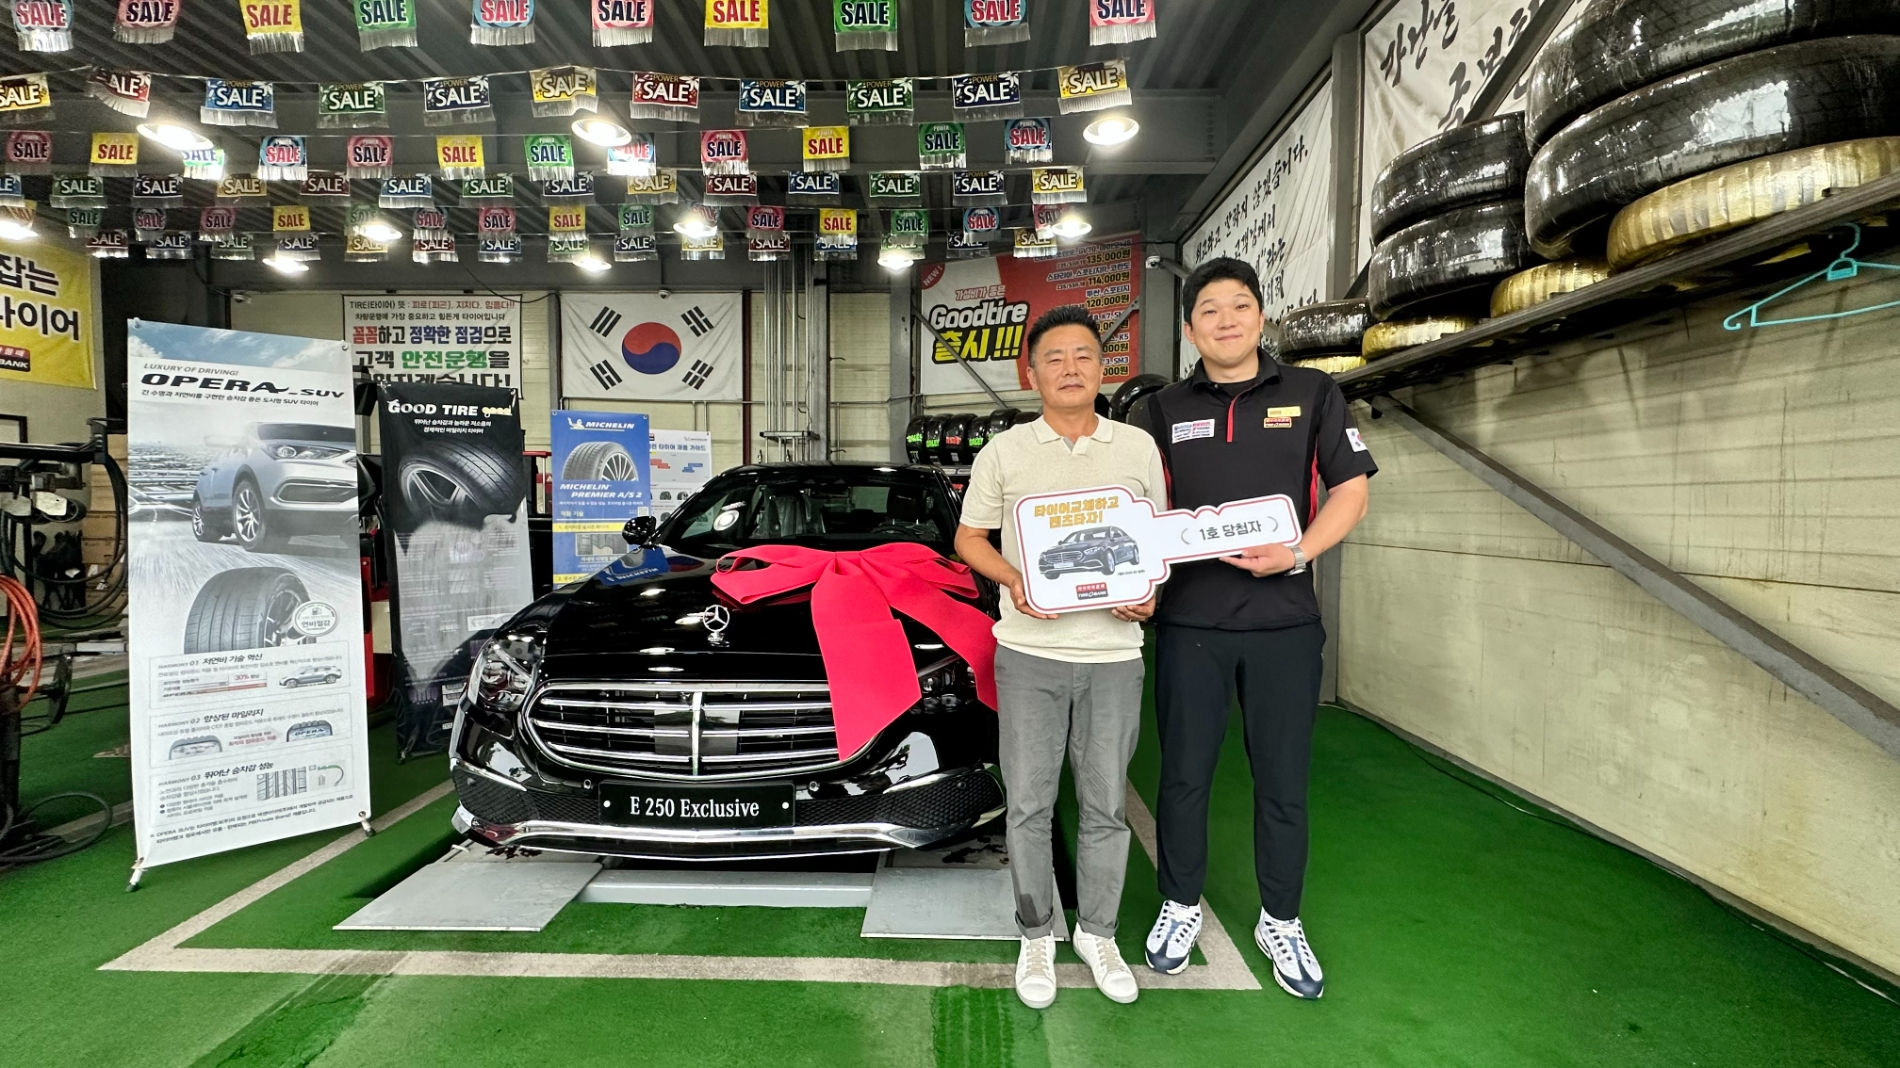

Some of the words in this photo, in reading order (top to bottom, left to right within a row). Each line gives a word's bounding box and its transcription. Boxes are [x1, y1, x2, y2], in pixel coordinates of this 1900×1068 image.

[16, 3, 66, 26] SALE
[126, 1, 174, 22] SALE
[247, 4, 292, 27] SALE
[360, 1, 407, 24] SALE
[482, 1, 528, 21] SALE
[599, 0, 645, 21] SALE
[713, 1, 760, 22] SALE
[842, 2, 889, 25] SALE
[972, 0, 1021, 21] SALE
[1099, 0, 1146, 19] SALE
[542, 72, 588, 98] SALE
[1070, 68, 1119, 94] SALE
[217, 87, 263, 107] SALE
[329, 91, 375, 109] SALE
[435, 86, 480, 107] SALE
[643, 82, 690, 102] SALE
[750, 88, 796, 108] SALE
[858, 88, 904, 108] SALE
[964, 81, 1011, 104] SALE
[925, 133, 960, 151] SALE
[1010, 129, 1046, 146] SALE
[14, 142, 48, 158] SALE
[99, 144, 134, 160] SALE
[354, 146, 387, 162] SALE
[442, 146, 476, 162] SALE
[530, 145, 565, 162] SALE
[707, 142, 741, 158] SALE
[809, 138, 843, 154] SALE
[266, 147, 301, 163] SALE
[61, 180, 97, 194] SALE
[142, 180, 177, 194] SALE
[225, 179, 260, 194] SALE
[307, 178, 342, 192] SALE
[388, 179, 424, 193] SALE
[470, 180, 506, 193] SALE
[552, 180, 587, 193] SALE
[633, 177, 670, 191] SALE
[714, 178, 750, 192] SALE
[796, 177, 833, 190] SALE
[877, 179, 914, 193] SALE
[961, 179, 998, 192] SALE
[1040, 174, 1077, 190] SALE
[70, 211, 99, 225] SALE
[137, 213, 164, 228] SALE
[206, 214, 233, 228] SALE
[278, 213, 305, 227] SALE
[416, 212, 445, 228] SALE
[484, 214, 511, 229] SALE
[554, 214, 581, 228] SALE
[623, 210, 650, 225] SALE
[752, 213, 779, 228] SALE
[824, 217, 852, 231] SALE
[896, 218, 924, 233] SALE
[968, 216, 996, 230] SALE
[92, 231, 121, 246] SALE
[157, 235, 185, 248] SALE
[220, 234, 247, 248] SALE
[285, 237, 313, 249] SALE
[421, 239, 449, 250] SALE
[487, 239, 515, 251] SALE
[555, 240, 583, 251] SALE
[621, 239, 650, 250] SALE
[755, 238, 784, 249] SALE
[391, 313, 406, 321] 가장
[407, 313, 436, 321] 중요하고
[462, 313, 506, 321] 타이어입니다
[931, 300, 1028, 331] Goodtire
[353, 325, 406, 344] 꼼꼼하고
[410, 325, 451, 344] 정확한
[455, 325, 512, 344] 점검으로
[355, 350, 395, 368] 고객
[401, 350, 510, 369] 안전운행을
[143, 363, 183, 371] LUXURY
[198, 367, 239, 376] DRIVING!
[388, 402, 437, 415] GOOD
[442, 404, 479, 416] TIRE
[585, 421, 635, 430] MICHELIN
[1034, 496, 1119, 517] 타이어교체하고
[1049, 511, 1103, 529] 벤츠타자!
[1199, 525, 1220, 542] 1호
[1222, 520, 1262, 539] 당첨자
[202, 657, 228, 665] 저연비
[229, 655, 245, 663] 기술
[247, 653, 263, 661] 혁신
[204, 713, 230, 723] 향상된
[232, 708, 264, 720] 마일리지
[204, 768, 230, 779] 뛰어난
[232, 765, 257, 776] 승차감
[259, 762, 274, 771] 성능
[630, 796, 640, 815] E
[645, 798, 675, 817] 250
[680, 798, 760, 818] Exclusive
